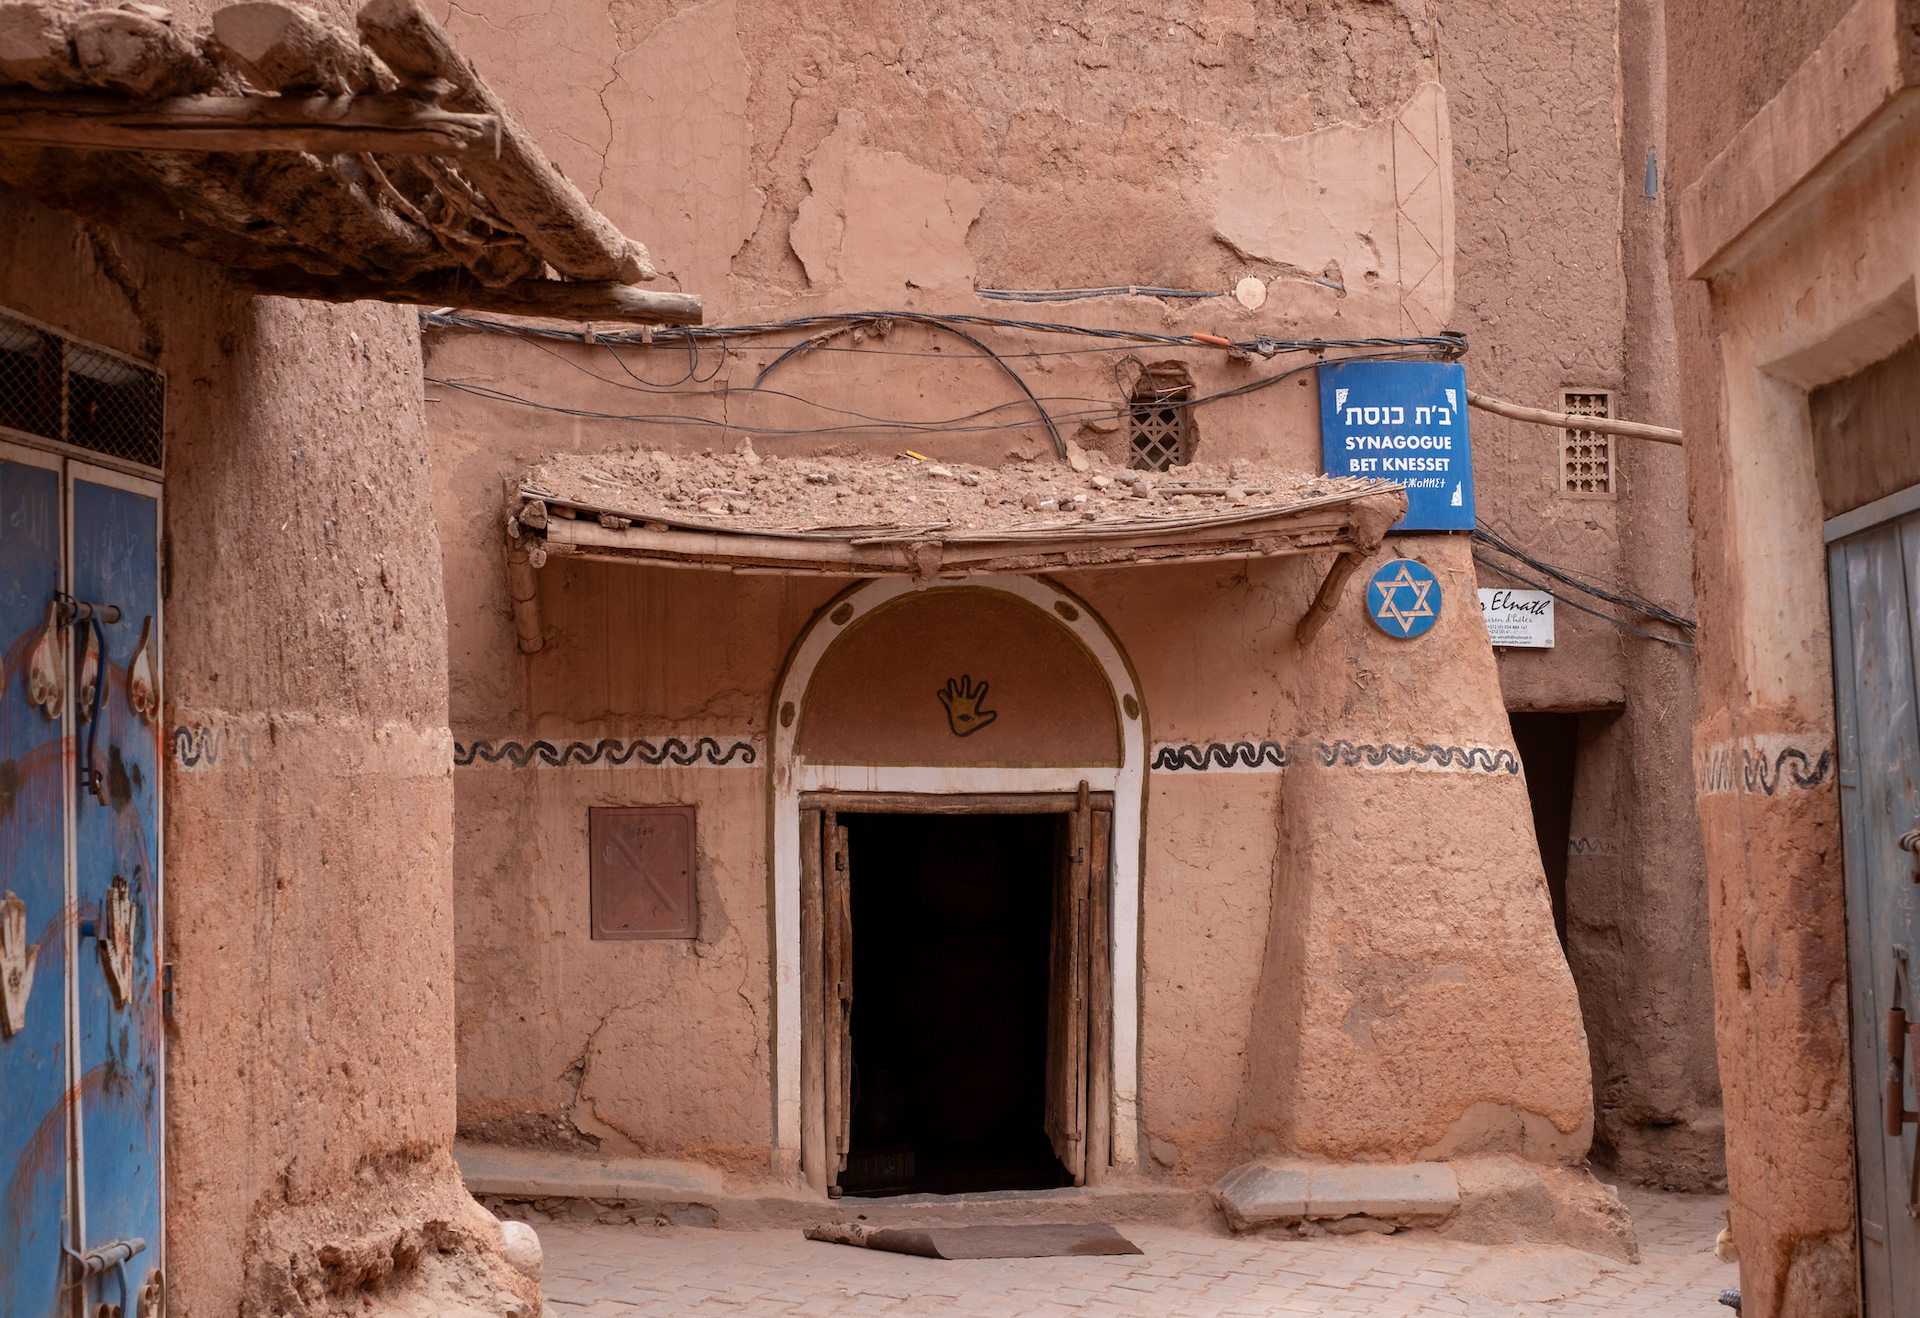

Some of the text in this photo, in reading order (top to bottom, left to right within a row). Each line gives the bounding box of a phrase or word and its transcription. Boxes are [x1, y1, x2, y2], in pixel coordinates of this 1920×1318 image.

[1345, 407, 1404, 426] כנסת
[1345, 435, 1452, 451] SYNAGOGUE
[1349, 457, 1450, 472] BET KNESSET
[1491, 591, 1551, 615] Elnath
